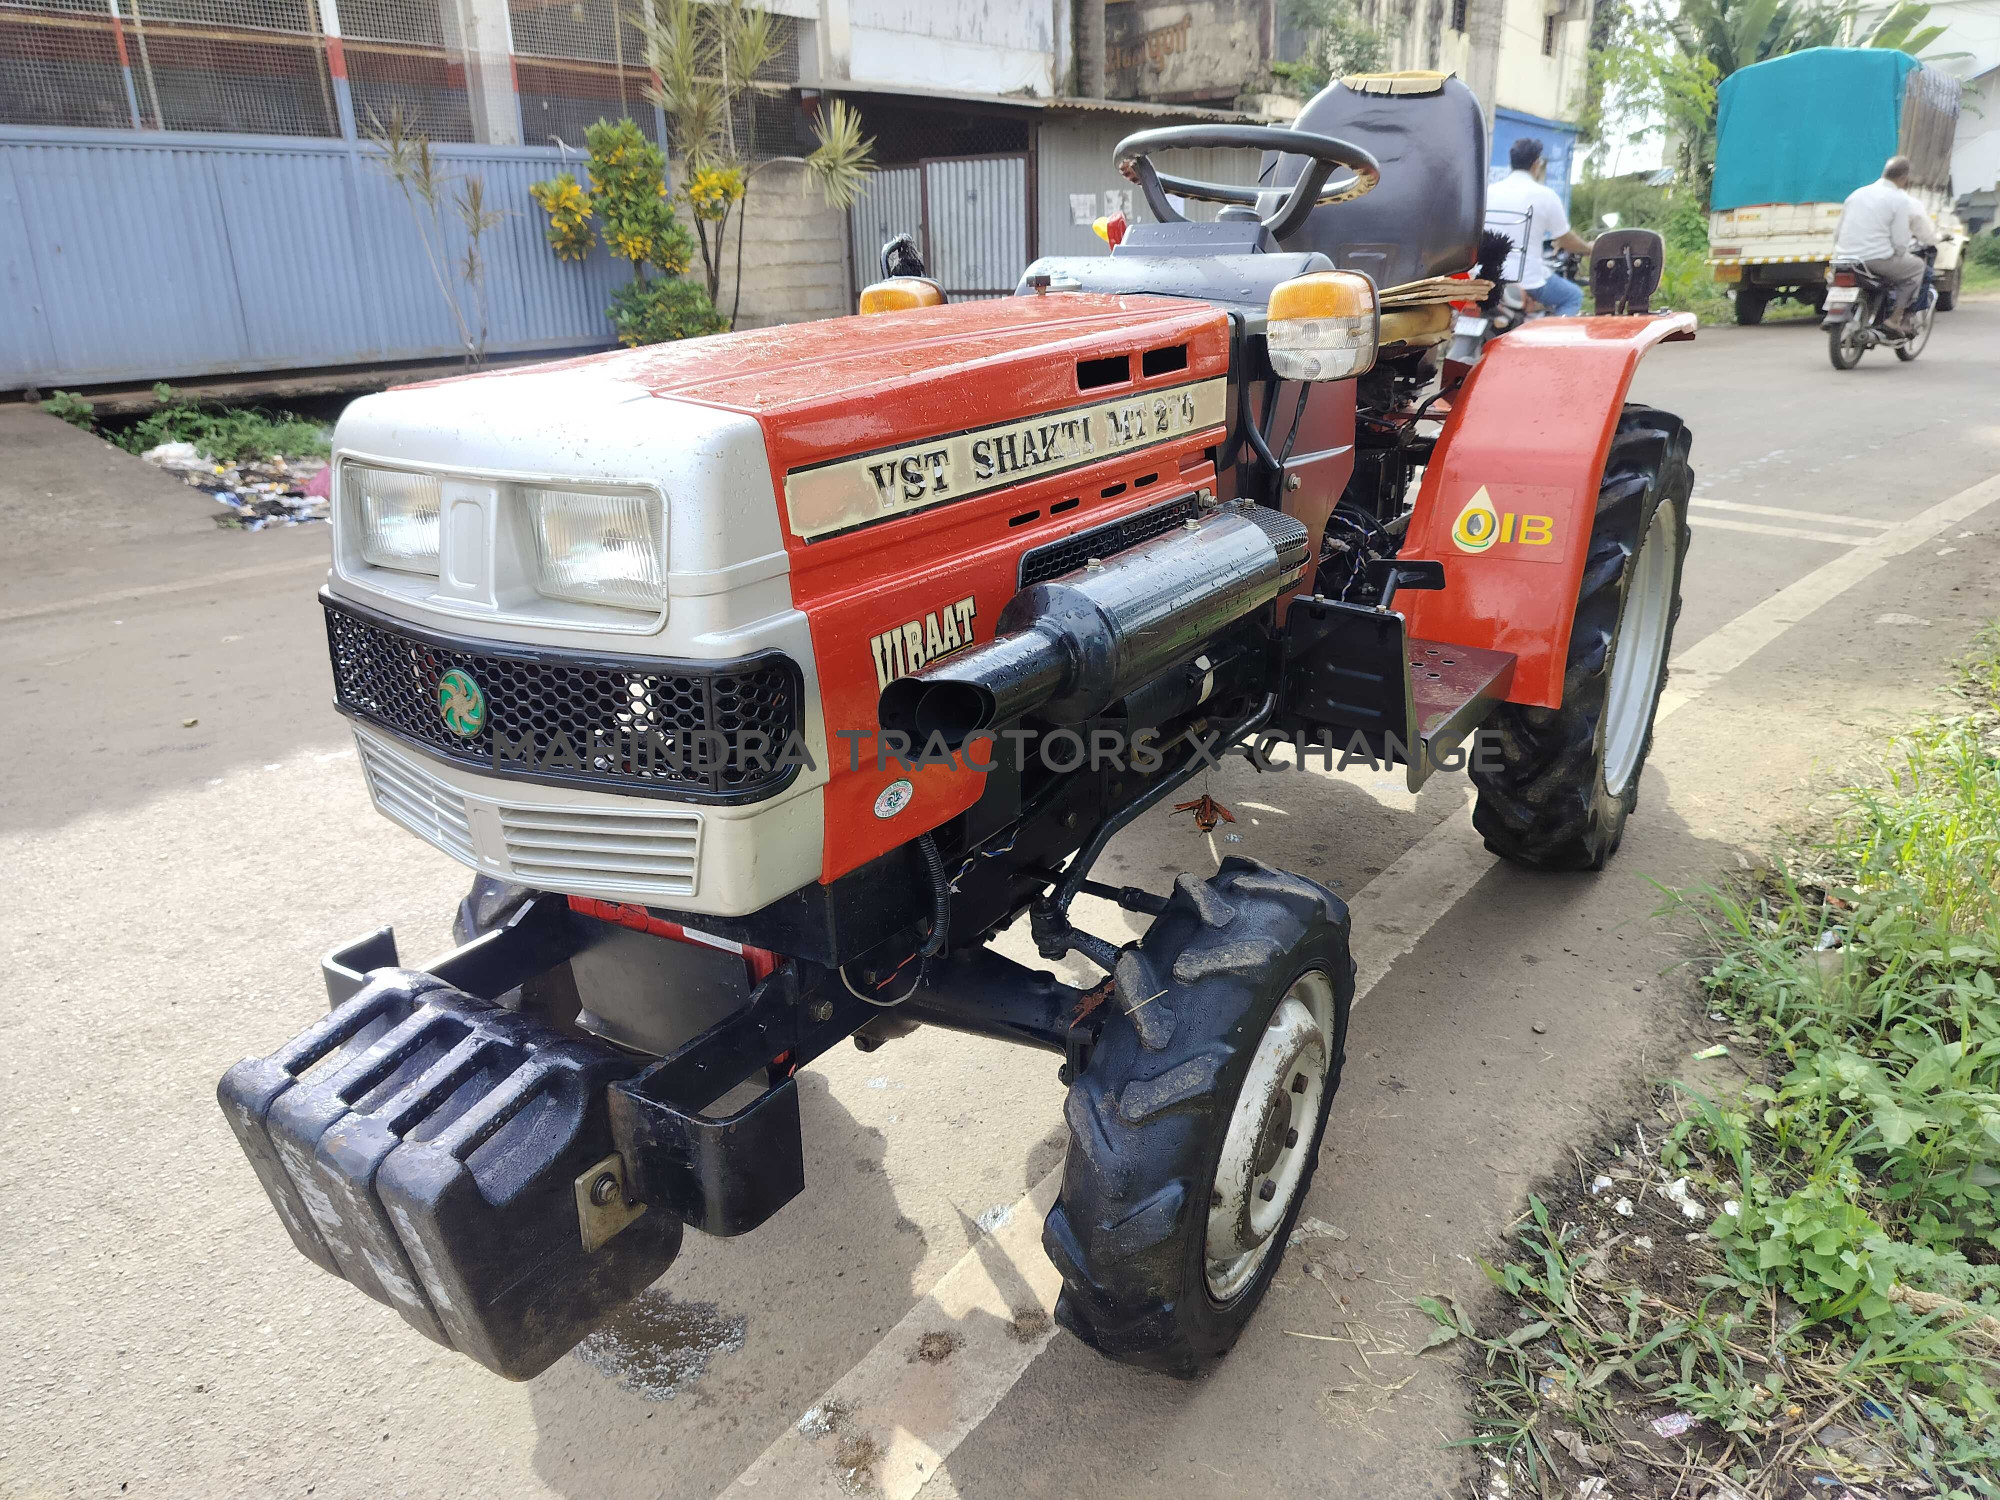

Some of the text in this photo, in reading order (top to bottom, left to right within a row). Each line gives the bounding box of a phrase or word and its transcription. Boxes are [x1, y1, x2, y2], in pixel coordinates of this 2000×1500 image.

[868, 449, 950, 508] VST
[971, 415, 1095, 484] SHAKTI
[1106, 401, 1148, 449] MT
[1458, 507, 1554, 546] OIB
[869, 594, 977, 695] VIRAAT
